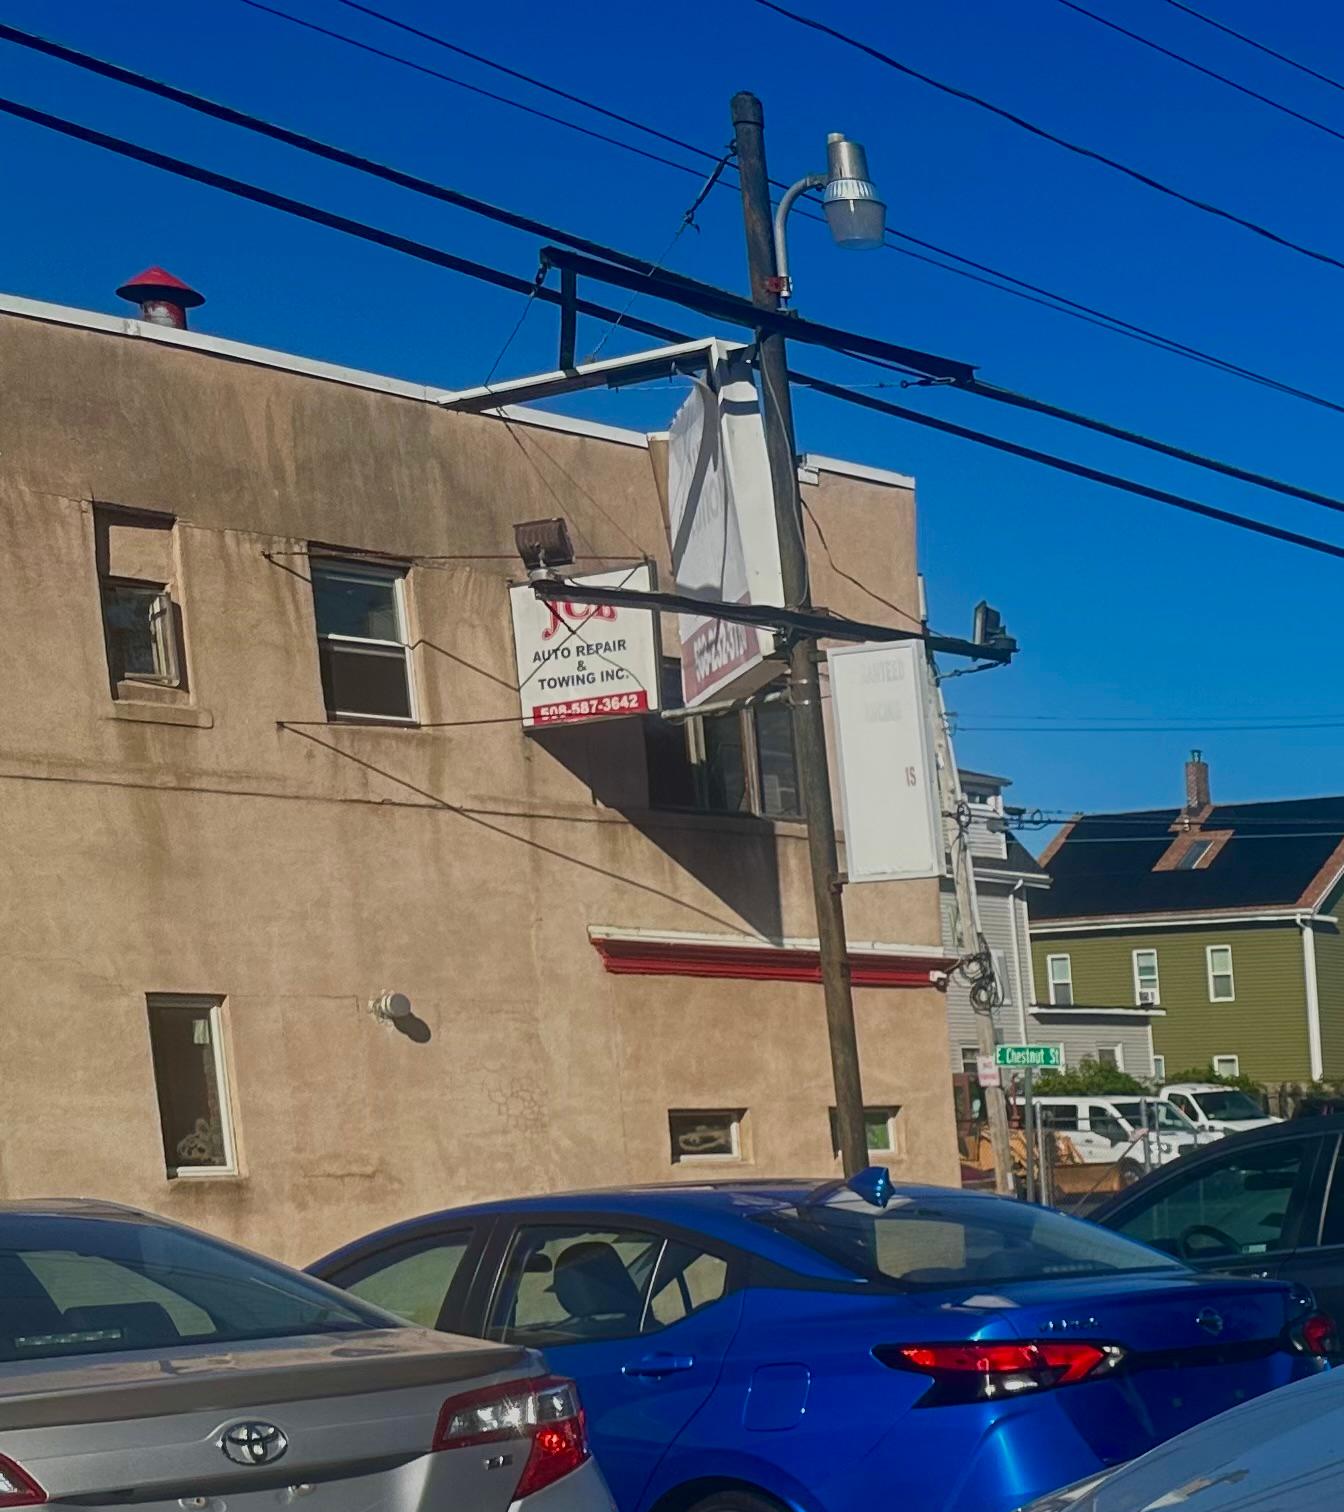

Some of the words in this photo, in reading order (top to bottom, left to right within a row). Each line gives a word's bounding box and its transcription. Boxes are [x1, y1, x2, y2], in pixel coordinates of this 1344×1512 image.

[532, 647, 571, 663] AUTO
[576, 639, 627, 657] REPAIR
[577, 660, 587, 671] &
[538, 672, 596, 690] TOWING
[600, 668, 630, 683] INC.
[1006, 1046, 1045, 1064] Chestnut
[1049, 1046, 1060, 1064] St
